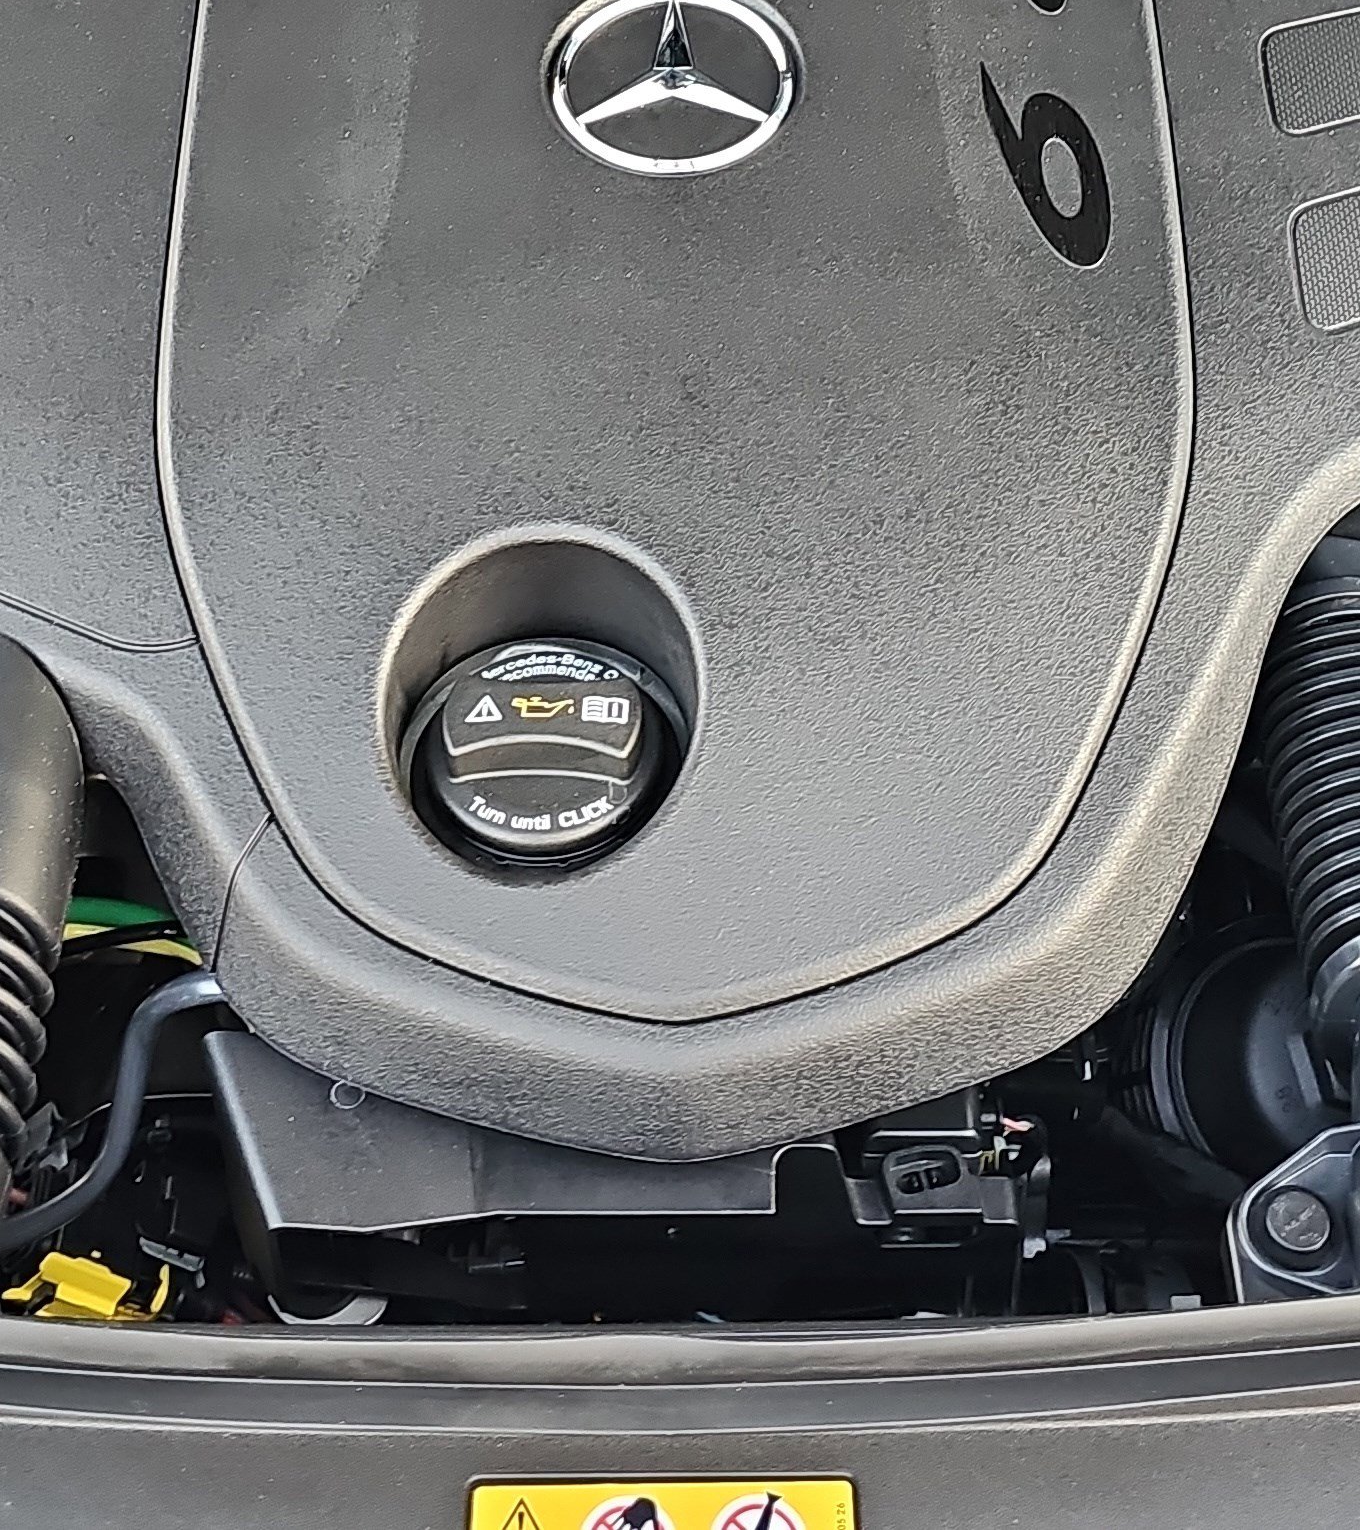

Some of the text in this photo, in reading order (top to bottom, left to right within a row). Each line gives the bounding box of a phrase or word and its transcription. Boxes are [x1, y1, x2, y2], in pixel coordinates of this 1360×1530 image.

[977, 60, 1113, 270] 6
[468, 795, 615, 831] Turn until CLICK
